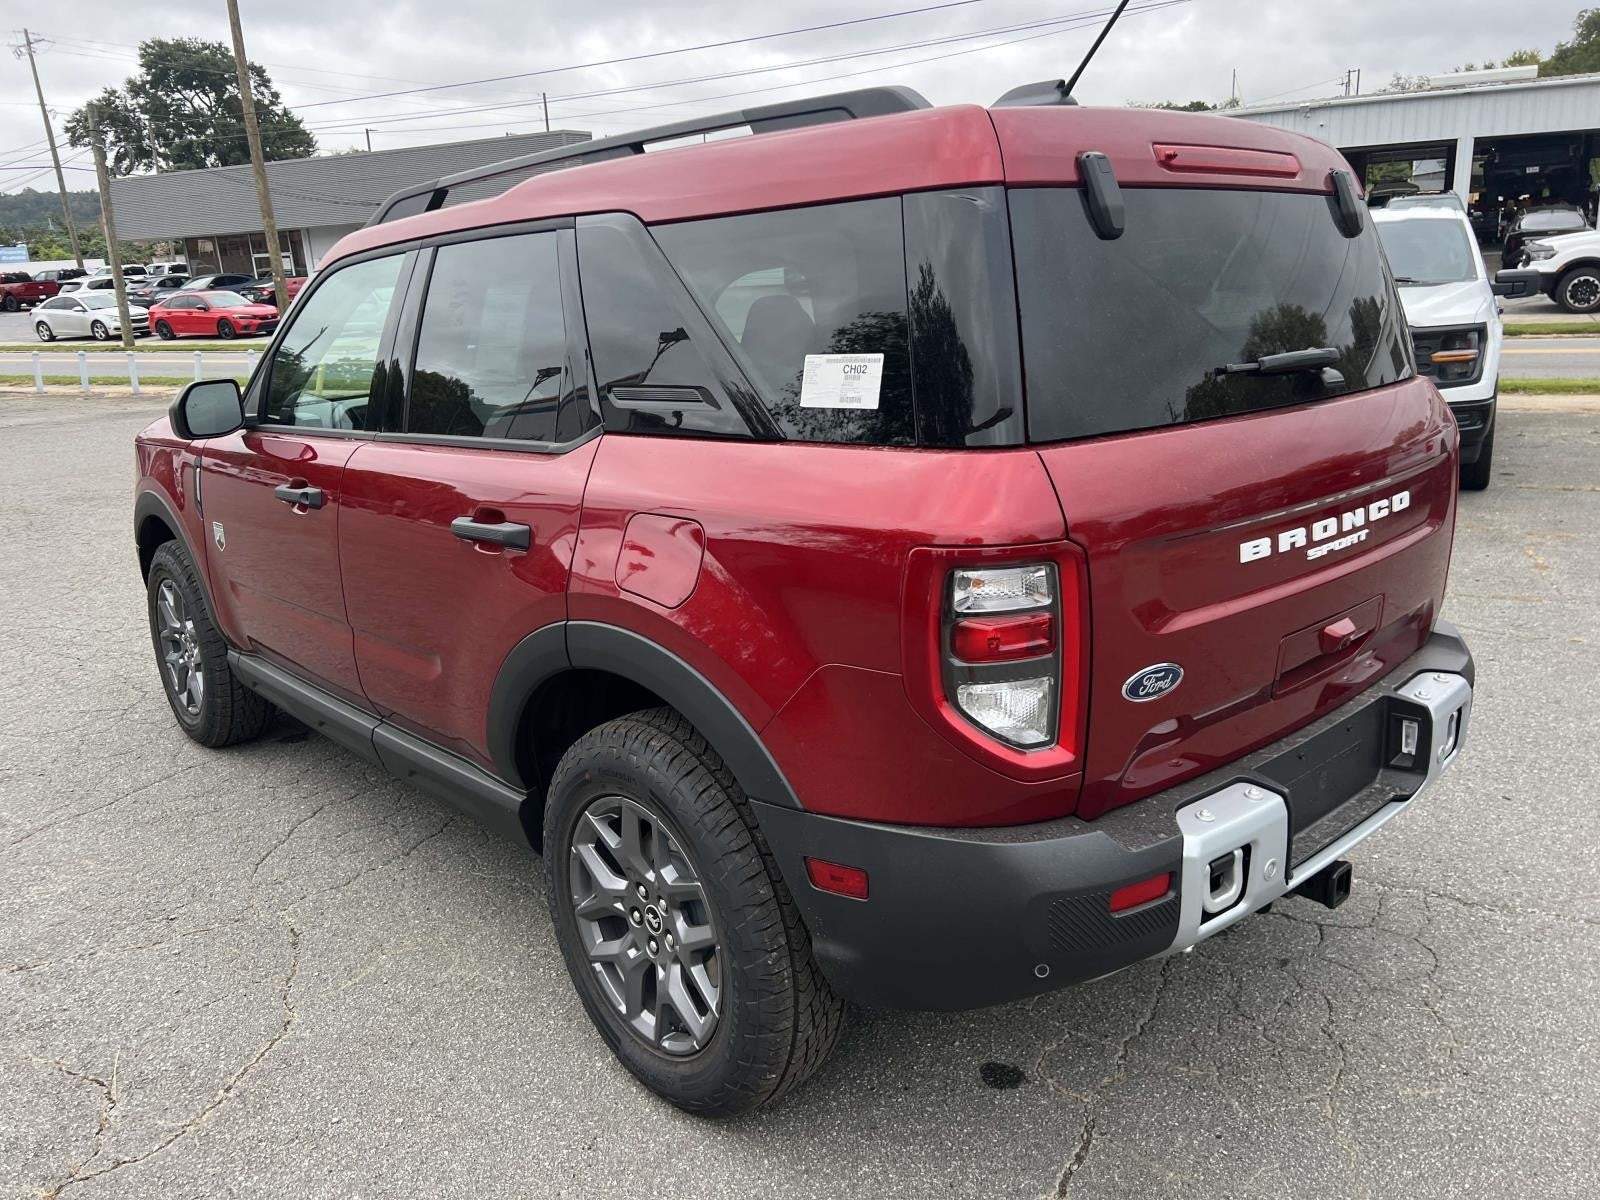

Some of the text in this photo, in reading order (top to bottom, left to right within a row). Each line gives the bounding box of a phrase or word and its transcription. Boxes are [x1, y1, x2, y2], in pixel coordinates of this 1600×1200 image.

[843, 364, 868, 375] CH02
[1239, 490, 1410, 564] BRONCO
[1306, 529, 1370, 560] SPORT
[1138, 671, 1173, 696] Ford
